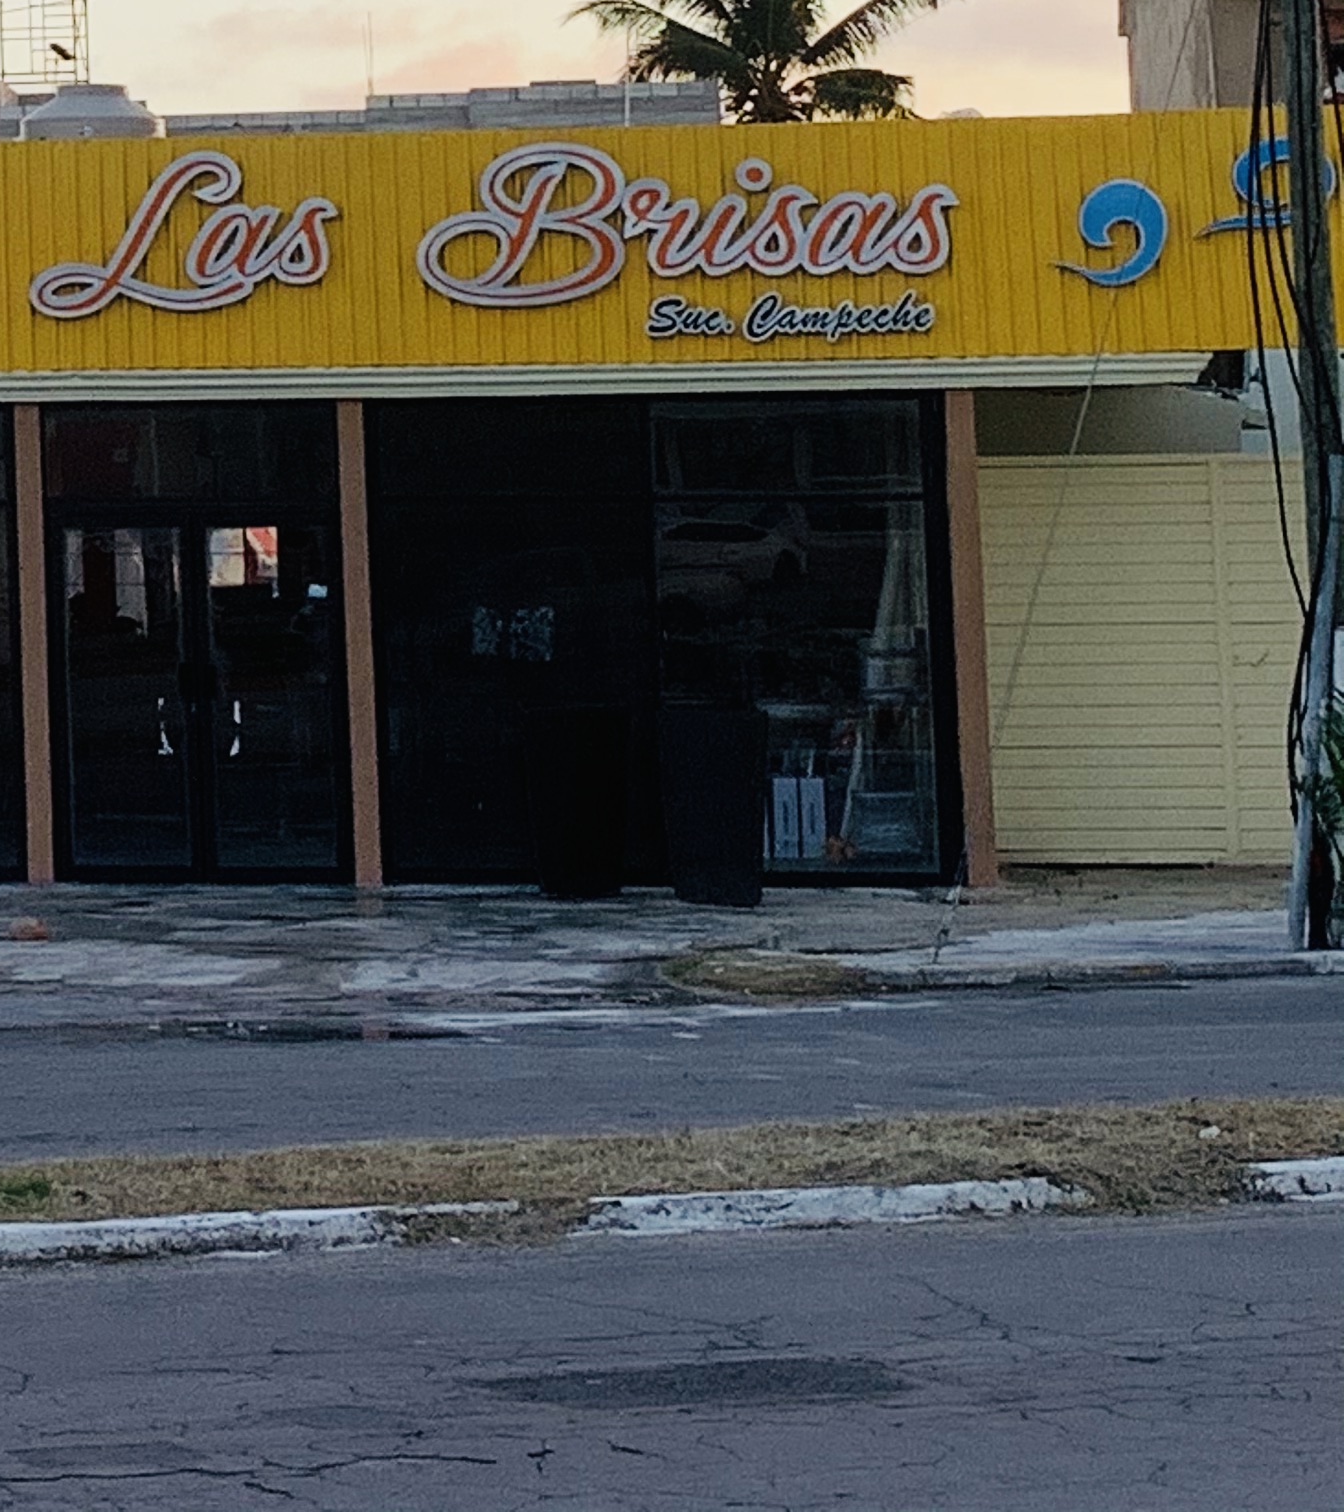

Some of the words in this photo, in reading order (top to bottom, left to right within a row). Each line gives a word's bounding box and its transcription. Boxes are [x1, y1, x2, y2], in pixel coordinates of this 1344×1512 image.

[29, 149, 340, 320] Las
[415, 139, 961, 308] Brisas
[646, 294, 736, 337] Suc.
[742, 288, 936, 343] Campeche
